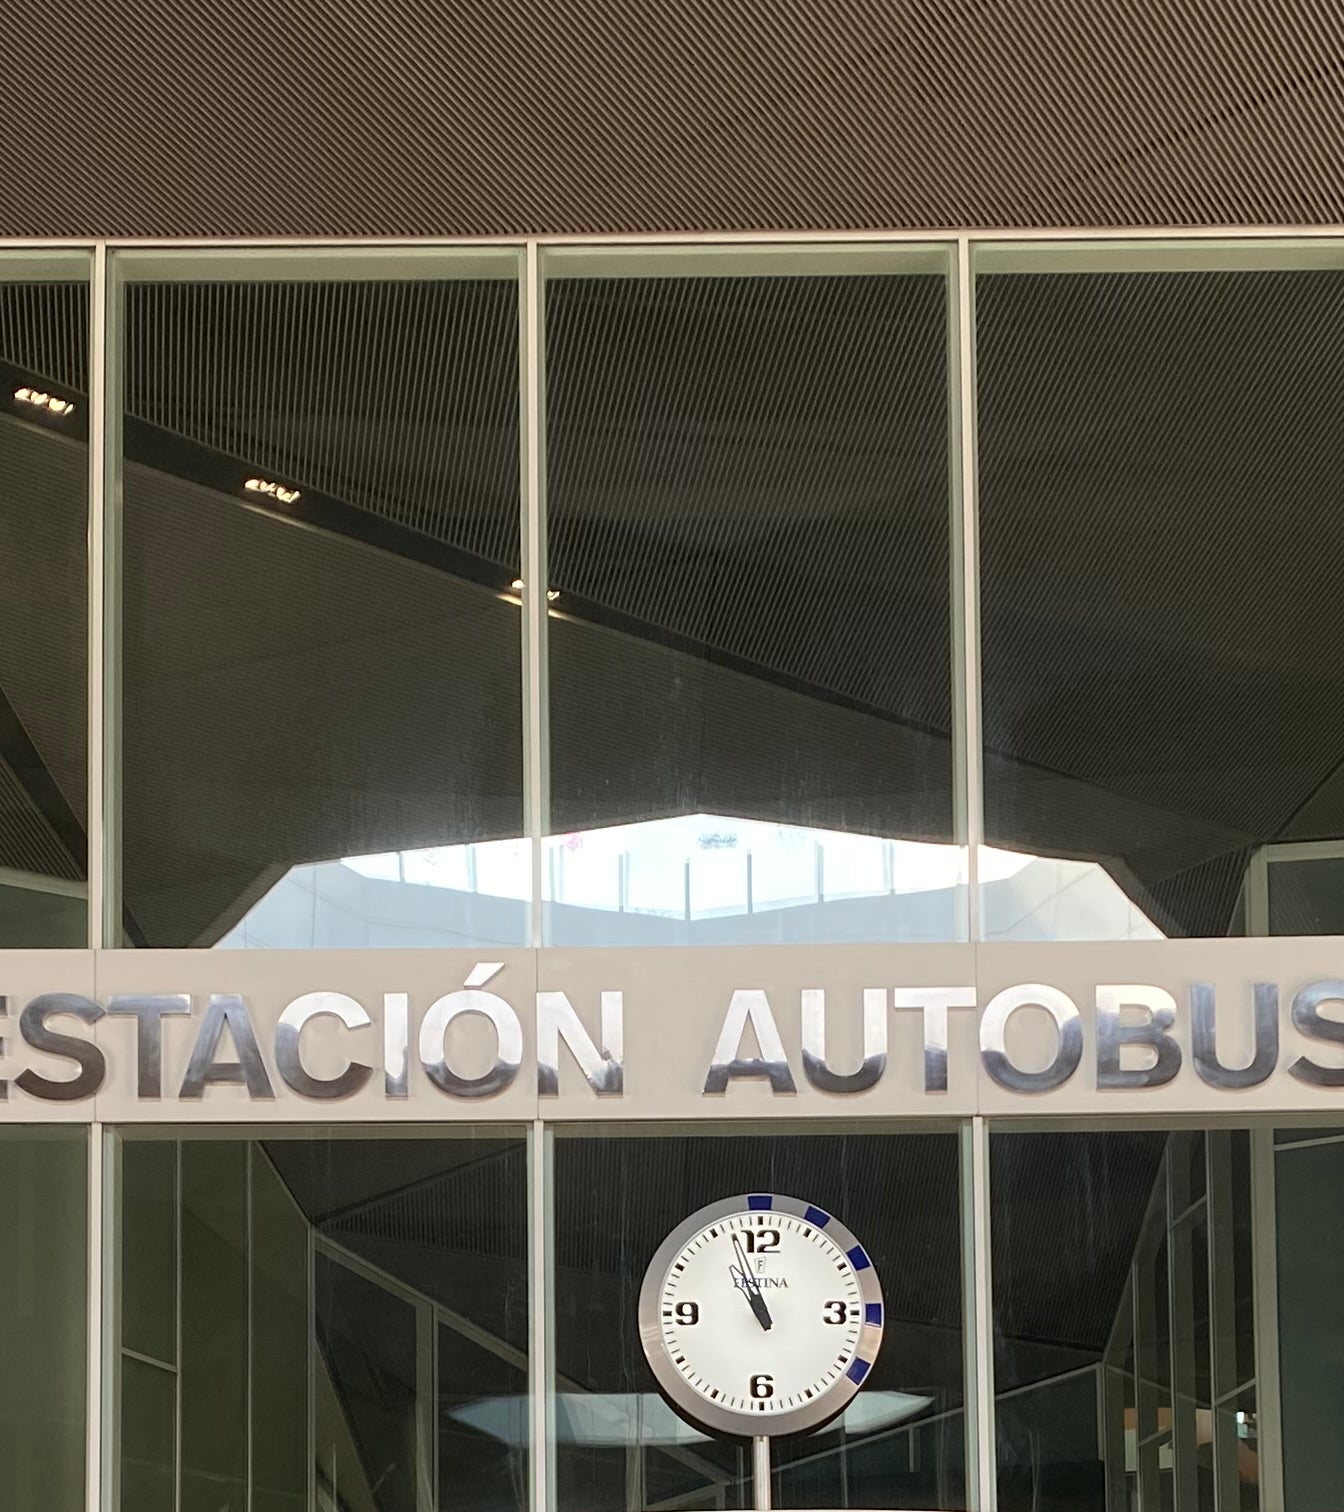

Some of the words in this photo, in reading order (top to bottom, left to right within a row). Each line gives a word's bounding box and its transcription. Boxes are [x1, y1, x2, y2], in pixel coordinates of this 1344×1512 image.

[740, 1229, 781, 1254] 12
[733, 1277, 789, 1289] FESTINA
[675, 1301, 699, 1326] 9
[823, 1301, 848, 1326] 3
[750, 1374, 774, 1399] 6
